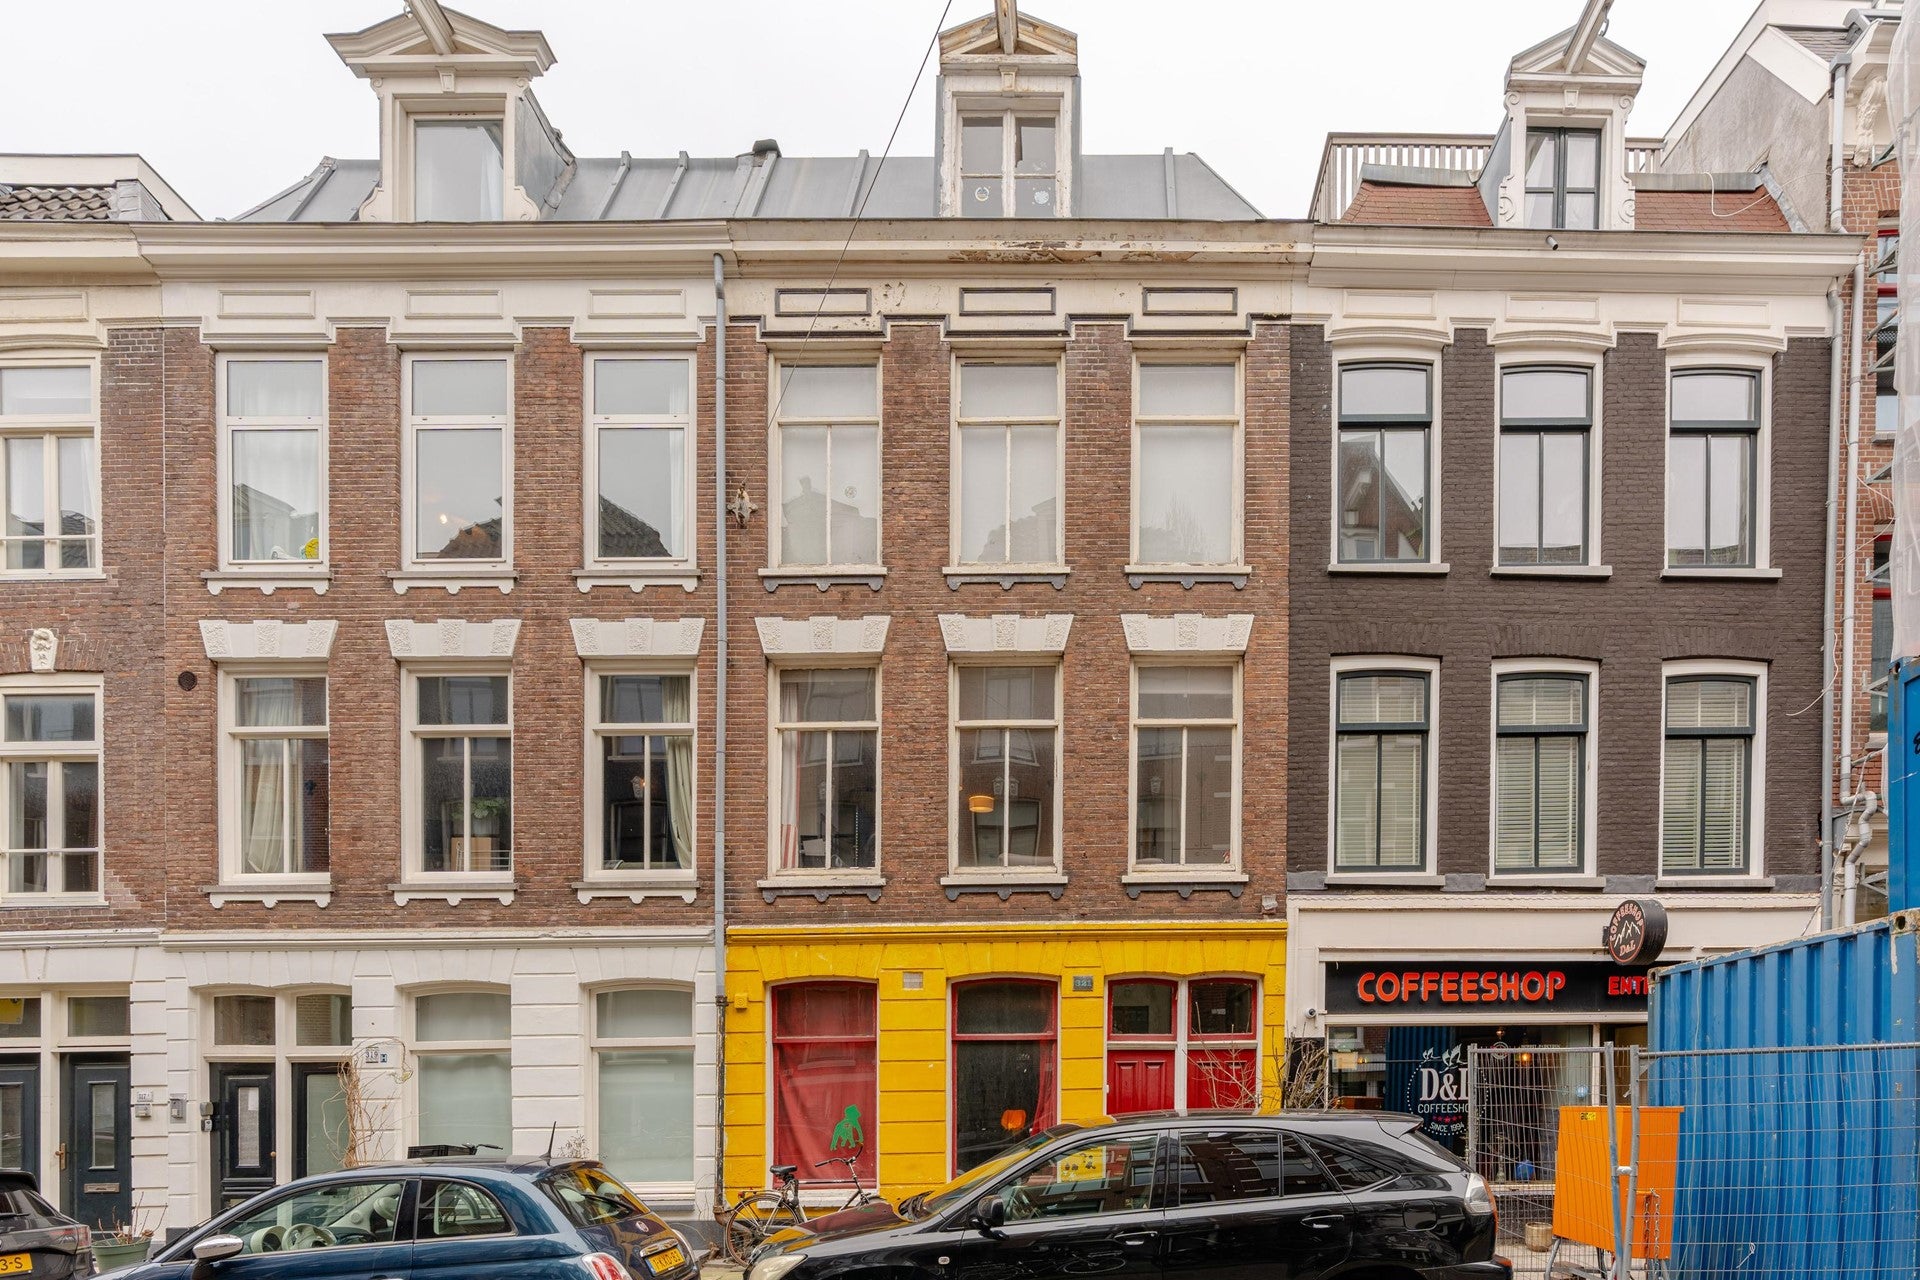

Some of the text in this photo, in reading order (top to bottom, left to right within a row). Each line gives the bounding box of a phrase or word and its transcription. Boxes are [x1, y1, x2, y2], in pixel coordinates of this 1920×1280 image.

[1609, 903, 1644, 941] COFFEESHOP
[1357, 971, 1566, 1002] COFFEESHOP
[1417, 1103, 1470, 1114] COFFEESHO
[1430, 1121, 1449, 1133] SINCE
